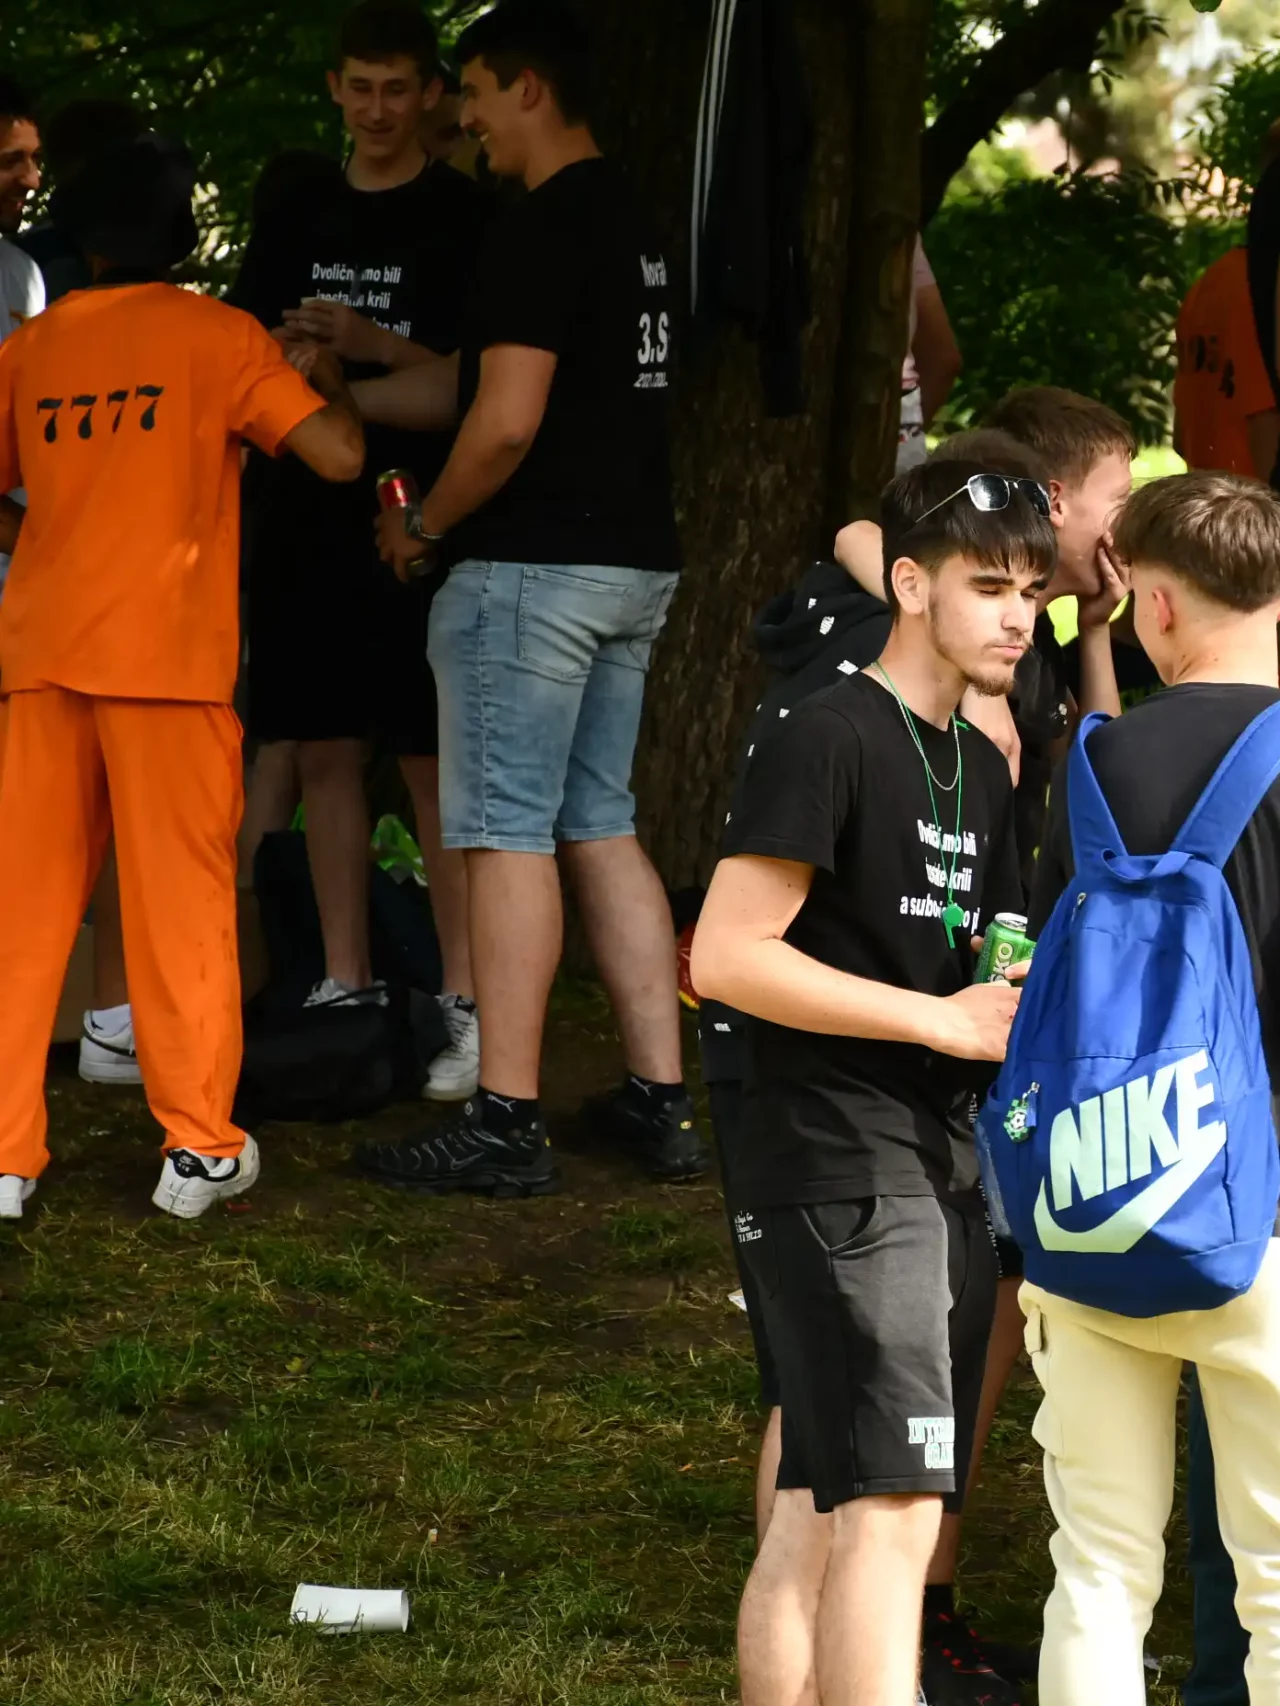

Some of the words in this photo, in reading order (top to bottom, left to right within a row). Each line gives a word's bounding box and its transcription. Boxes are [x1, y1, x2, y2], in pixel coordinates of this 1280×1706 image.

[311, 262, 356, 281] Dvoličn
[360, 267, 381, 282] mo
[383, 265, 402, 284] bili
[366, 289, 392, 309] krili
[36, 384, 164, 444] 7777
[900, 895, 909, 915] a
[1050, 1048, 1225, 1213] NIKE
